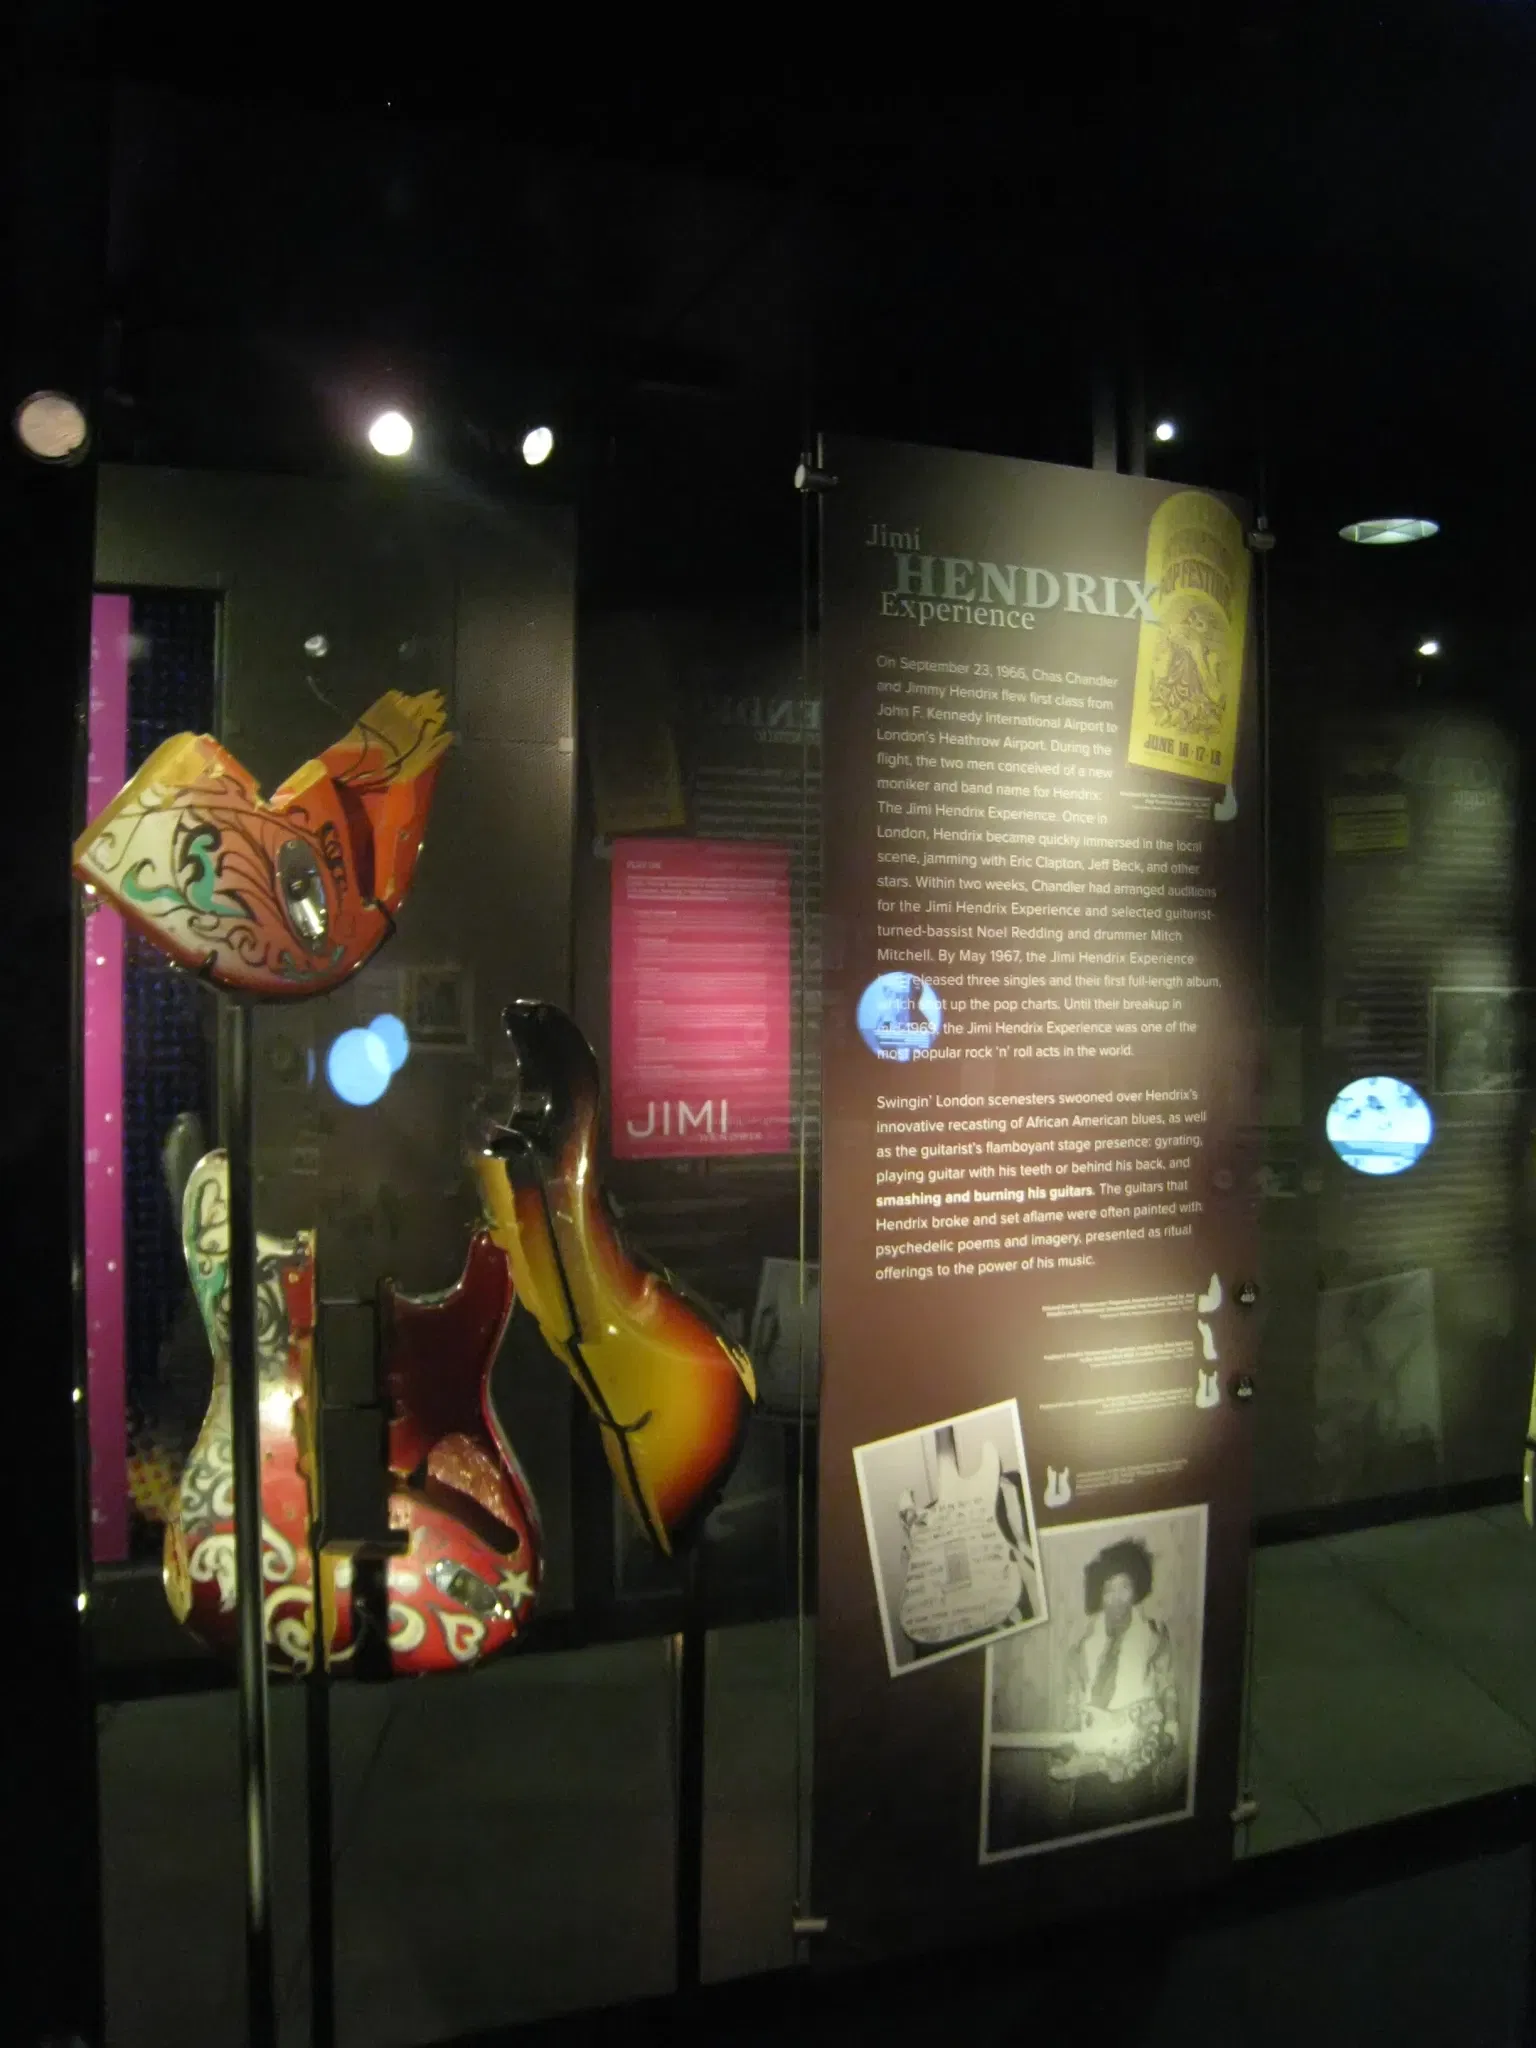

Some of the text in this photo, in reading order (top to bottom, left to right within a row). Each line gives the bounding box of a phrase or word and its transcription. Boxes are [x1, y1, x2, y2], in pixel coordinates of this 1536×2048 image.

[865, 523, 921, 551] Jimi
[893, 551, 1162, 623] HENDRIX
[879, 591, 1037, 631] Experience
[875, 657, 896, 670] On
[899, 659, 970, 678] September
[973, 664, 992, 679] 23,
[1031, 669, 1063, 683] Chas
[1064, 671, 1119, 687] Chandler
[877, 705, 909, 719] John
[926, 708, 982, 726] Kennedy
[985, 712, 1061, 729] International
[1063, 717, 1104, 734] Airport
[1105, 720, 1118, 732] to
[876, 729, 936, 744] London's
[938, 733, 1000, 748] Heathrow
[1050, 740, 1090, 757] During
[1092, 743, 1112, 756] the
[875, 777, 930, 791] moniker
[933, 780, 958, 793] and
[960, 781, 993, 794] band
[995, 786, 1030, 796] name
[1032, 785, 1050, 797] for
[876, 826, 929, 841] London,
[932, 828, 983, 842] Hendrix
[985, 831, 1036, 845] became
[1038, 833, 1080, 849] quickly
[1082, 835, 1141, 849] immersed
[1142, 837, 1153, 850] in
[1155, 838, 1174, 850] the
[876, 852, 1200, 874] scene, jamming with Eric Clapton, Jeff Beck, and other
[876, 875, 911, 888] stars.
[915, 876, 956, 890] Within
[958, 878, 982, 890] two
[984, 879, 1028, 893] weeks,
[1031, 880, 1086, 894] Chandler
[1088, 882, 1111, 895] had
[1113, 883, 1165, 899] arranged
[876, 900, 895, 912] for
[898, 901, 921, 913] the
[925, 901, 952, 914] Jimi
[955, 902, 1007, 915] Hendrix
[1010, 903, 1082, 919] Experience
[1084, 905, 1108, 917] and
[1111, 905, 1162, 918] selected
[876, 925, 1183, 942] turned-bassist Noel Redding and drummer Mitch
[876, 949, 1196, 968] Mitchell. By May 1967, the Jimi Hendrix Experience
[912, 1046, 962, 1062] popular
[964, 1046, 993, 1058] rock
[1013, 1046, 1033, 1058] roll
[1035, 1045, 1061, 1057] acts
[1062, 1045, 1075, 1057] in
[1076, 1045, 1096, 1057] the
[1098, 1044, 1134, 1057] world.
[935, 1094, 985, 1107] London
[987, 1092, 1056, 1106] scenesters
[1058, 1091, 1114, 1104] swooned
[1116, 1093, 1143, 1102] over
[1145, 1088, 1199, 1102] Hendrix's
[626, 1098, 728, 1138] JIMI
[876, 1110, 1208, 1133] innovative recasting of African American blues, as well
[875, 1148, 892, 1158] as
[894, 1144, 917, 1157] the
[920, 1142, 983, 1159] guitarist's
[985, 1140, 1055, 1157] flamboyant
[1057, 1139, 1091, 1154] stage
[875, 1156, 1192, 1184] playing guitar with his teeth or behind his back, and
[875, 1180, 1189, 1209] smashing and burning his guitars. The guitars that
[875, 1201, 1204, 1231] Hendrix broke and set aflame were often painted with
[875, 1223, 1193, 1258] psychedelic poems and imagery, presented as ritual
[874, 1254, 1095, 1282] offerings to the power of his music.
